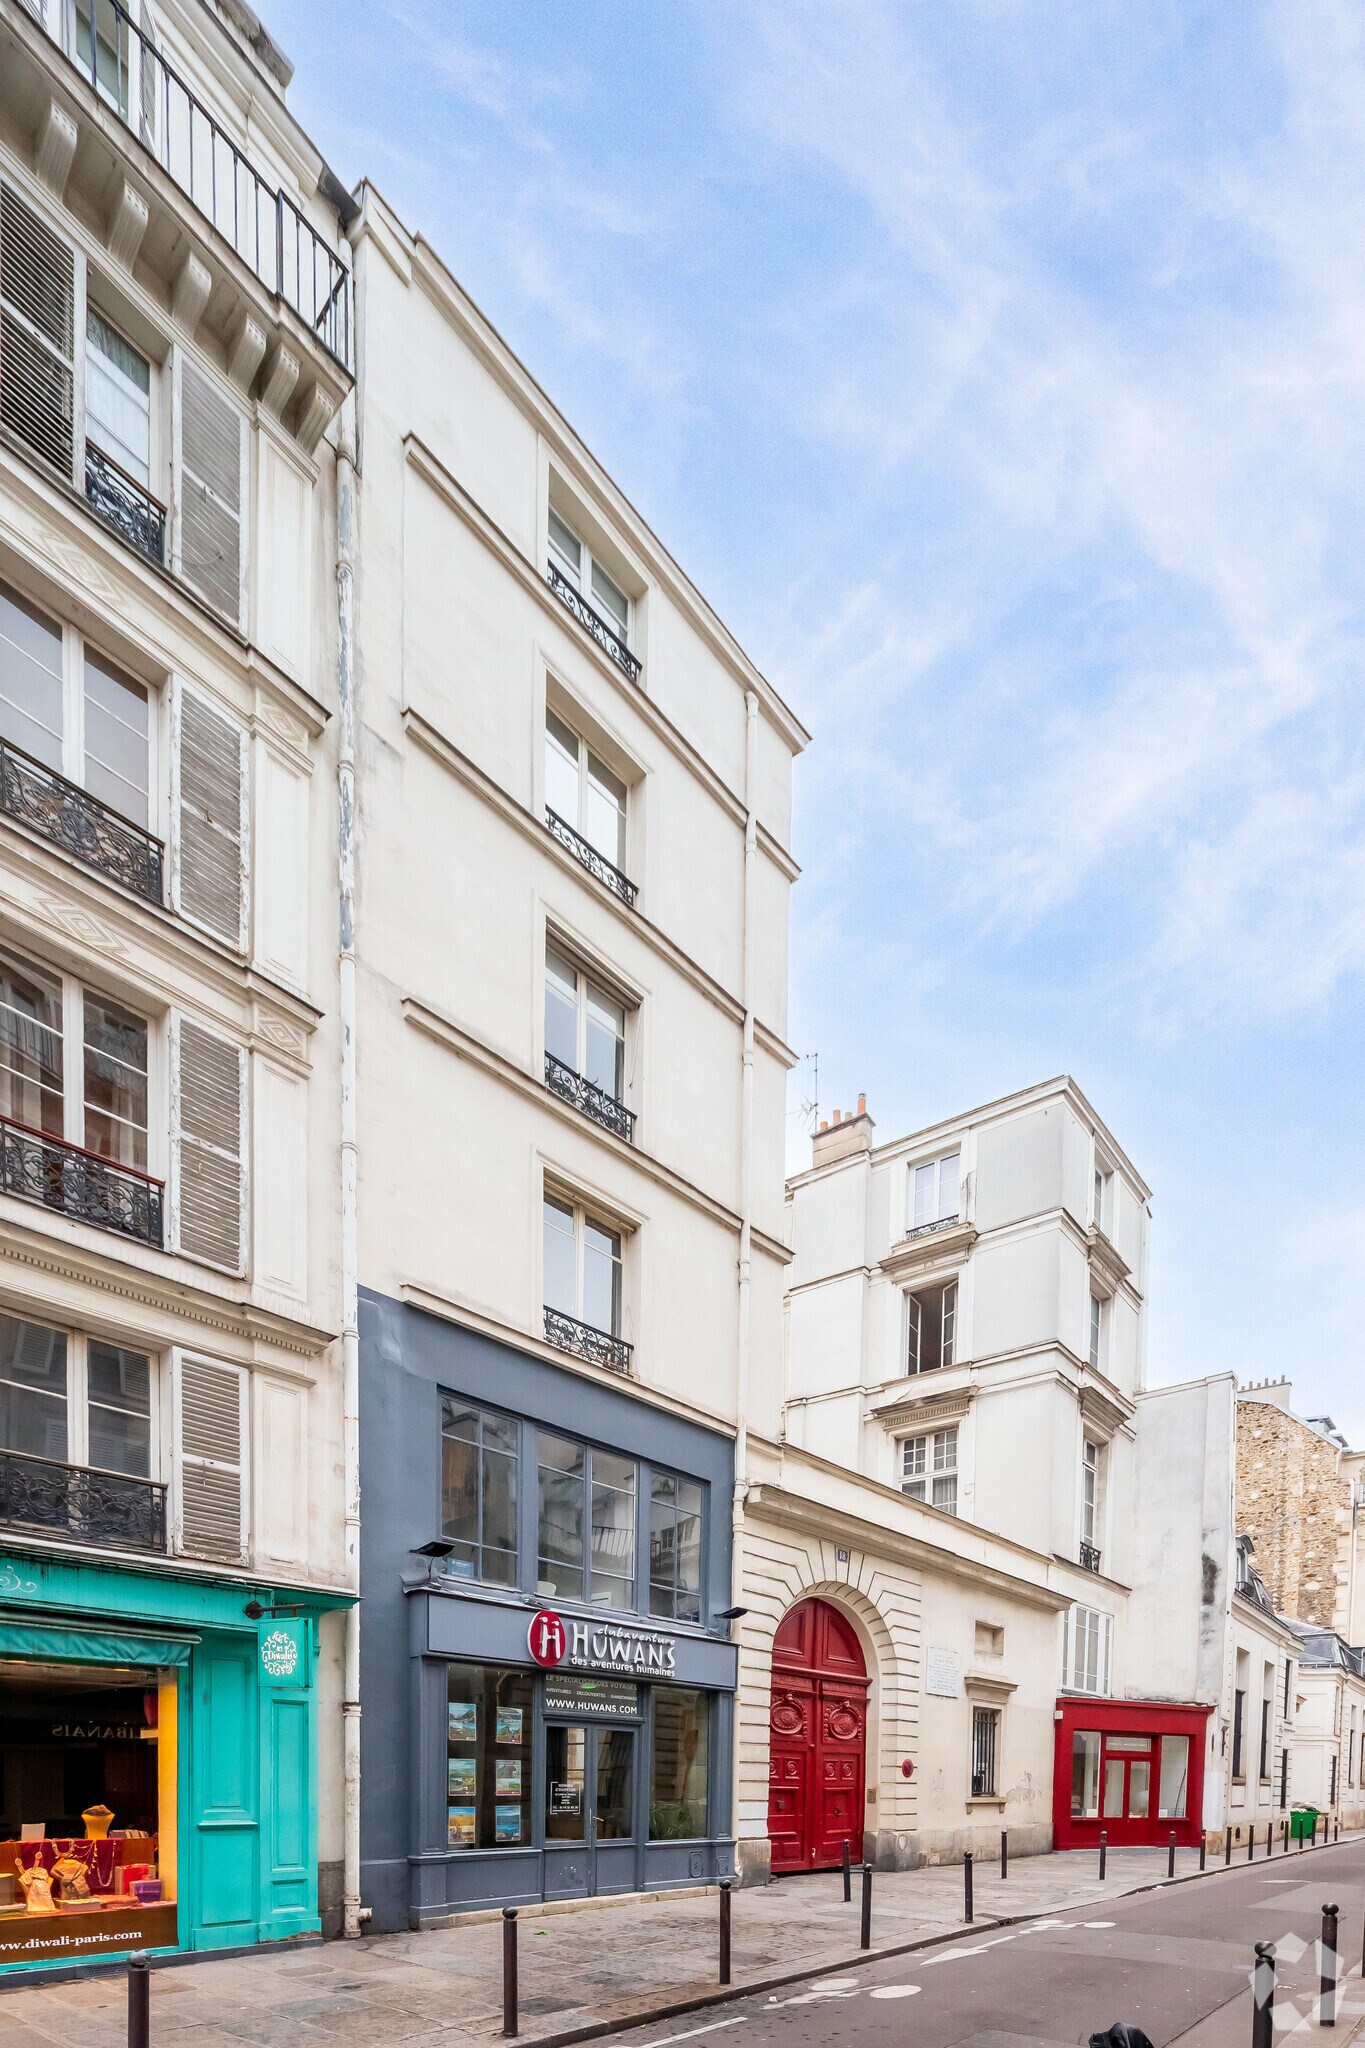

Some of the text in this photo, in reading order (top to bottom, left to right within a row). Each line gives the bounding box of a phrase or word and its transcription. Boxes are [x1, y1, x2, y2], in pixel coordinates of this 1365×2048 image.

[571, 1622, 676, 1669] HUWANS
[571, 1655, 676, 1677] des aventures humaines
[610, 1682, 638, 1691] VOYAGES
[545, 1698, 638, 1715] WWW.HUWANS.COM
